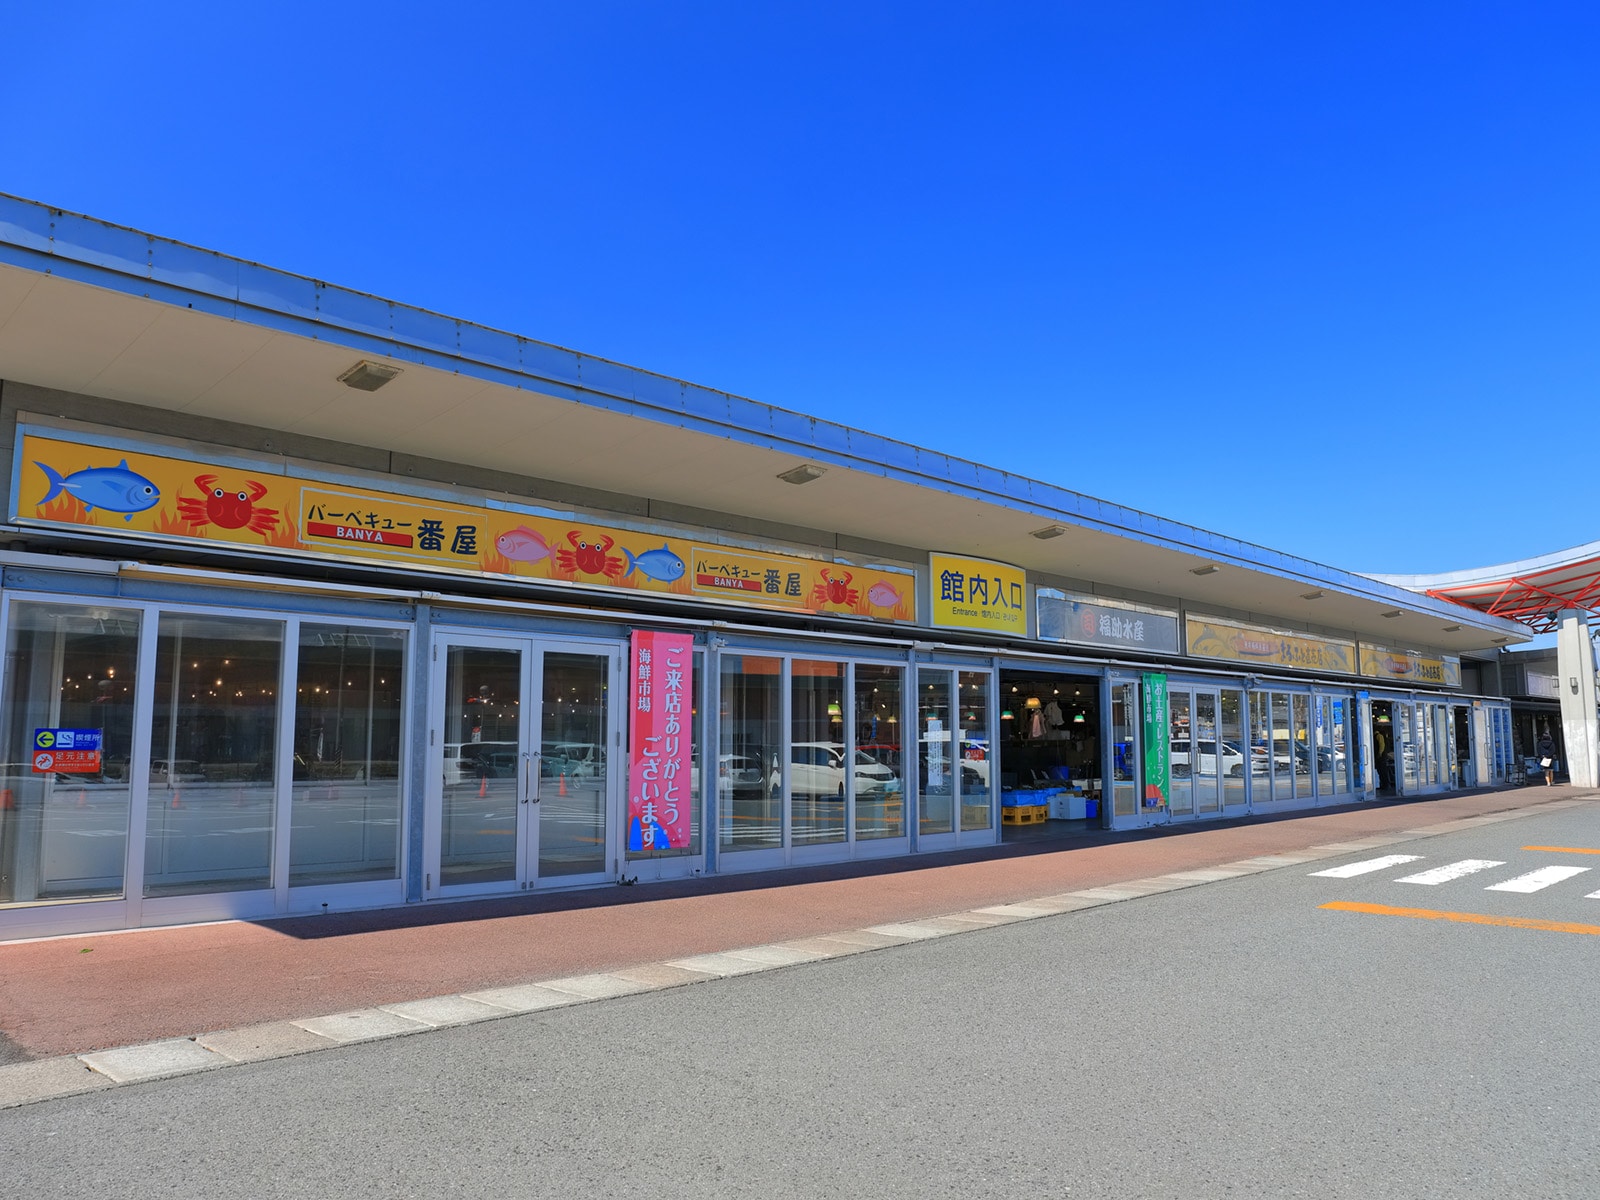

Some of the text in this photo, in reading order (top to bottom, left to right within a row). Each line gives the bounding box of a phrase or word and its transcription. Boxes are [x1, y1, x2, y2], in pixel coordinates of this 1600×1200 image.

[307, 503, 478, 555] バーベキュー 番屋
[336, 526, 384, 543] BANYA
[697, 559, 802, 596] バーベキュー 番屋
[714, 576, 744, 588] BANYA
[940, 569, 1022, 611] 館内入口
[952, 606, 978, 617] Entrance
[1099, 614, 1145, 642] 福助水産
[637, 648, 652, 713] 海鮮市場
[663, 647, 684, 826] ご来店ありがとう
[55, 751, 95, 760] 足元注意
[640, 735, 662, 848] ございます
